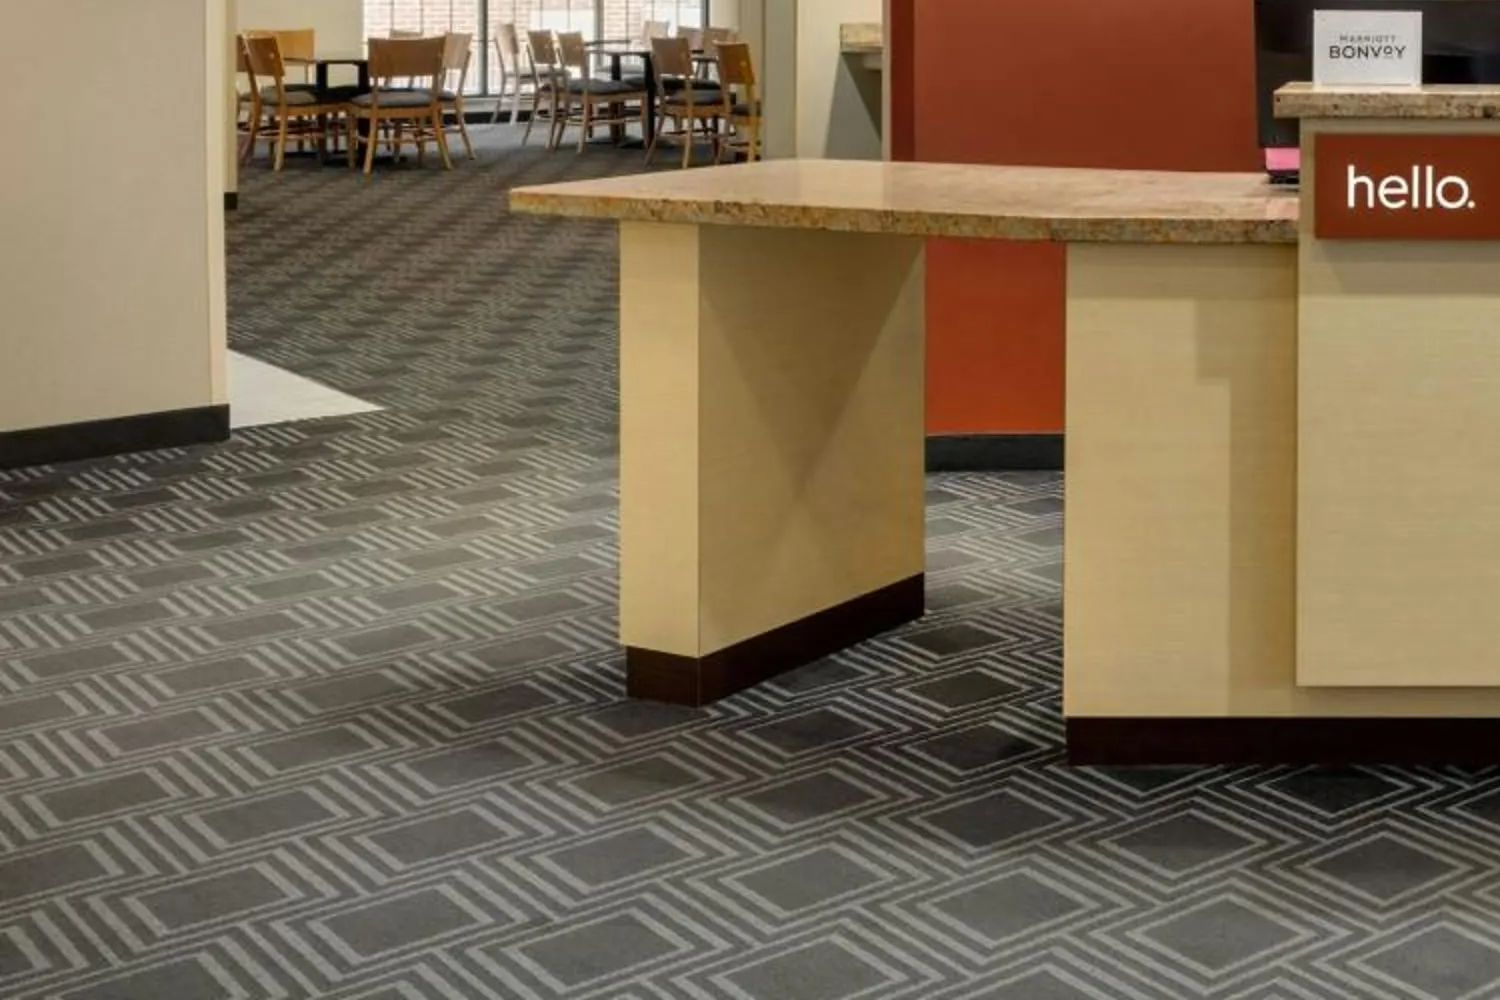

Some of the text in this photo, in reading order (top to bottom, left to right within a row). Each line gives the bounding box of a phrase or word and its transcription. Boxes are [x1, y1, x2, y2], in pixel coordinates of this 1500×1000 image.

[1339, 35, 1396, 43] MARRIOTT
[1329, 45, 1406, 59] BONVOY
[1347, 165, 1475, 208] hello.
